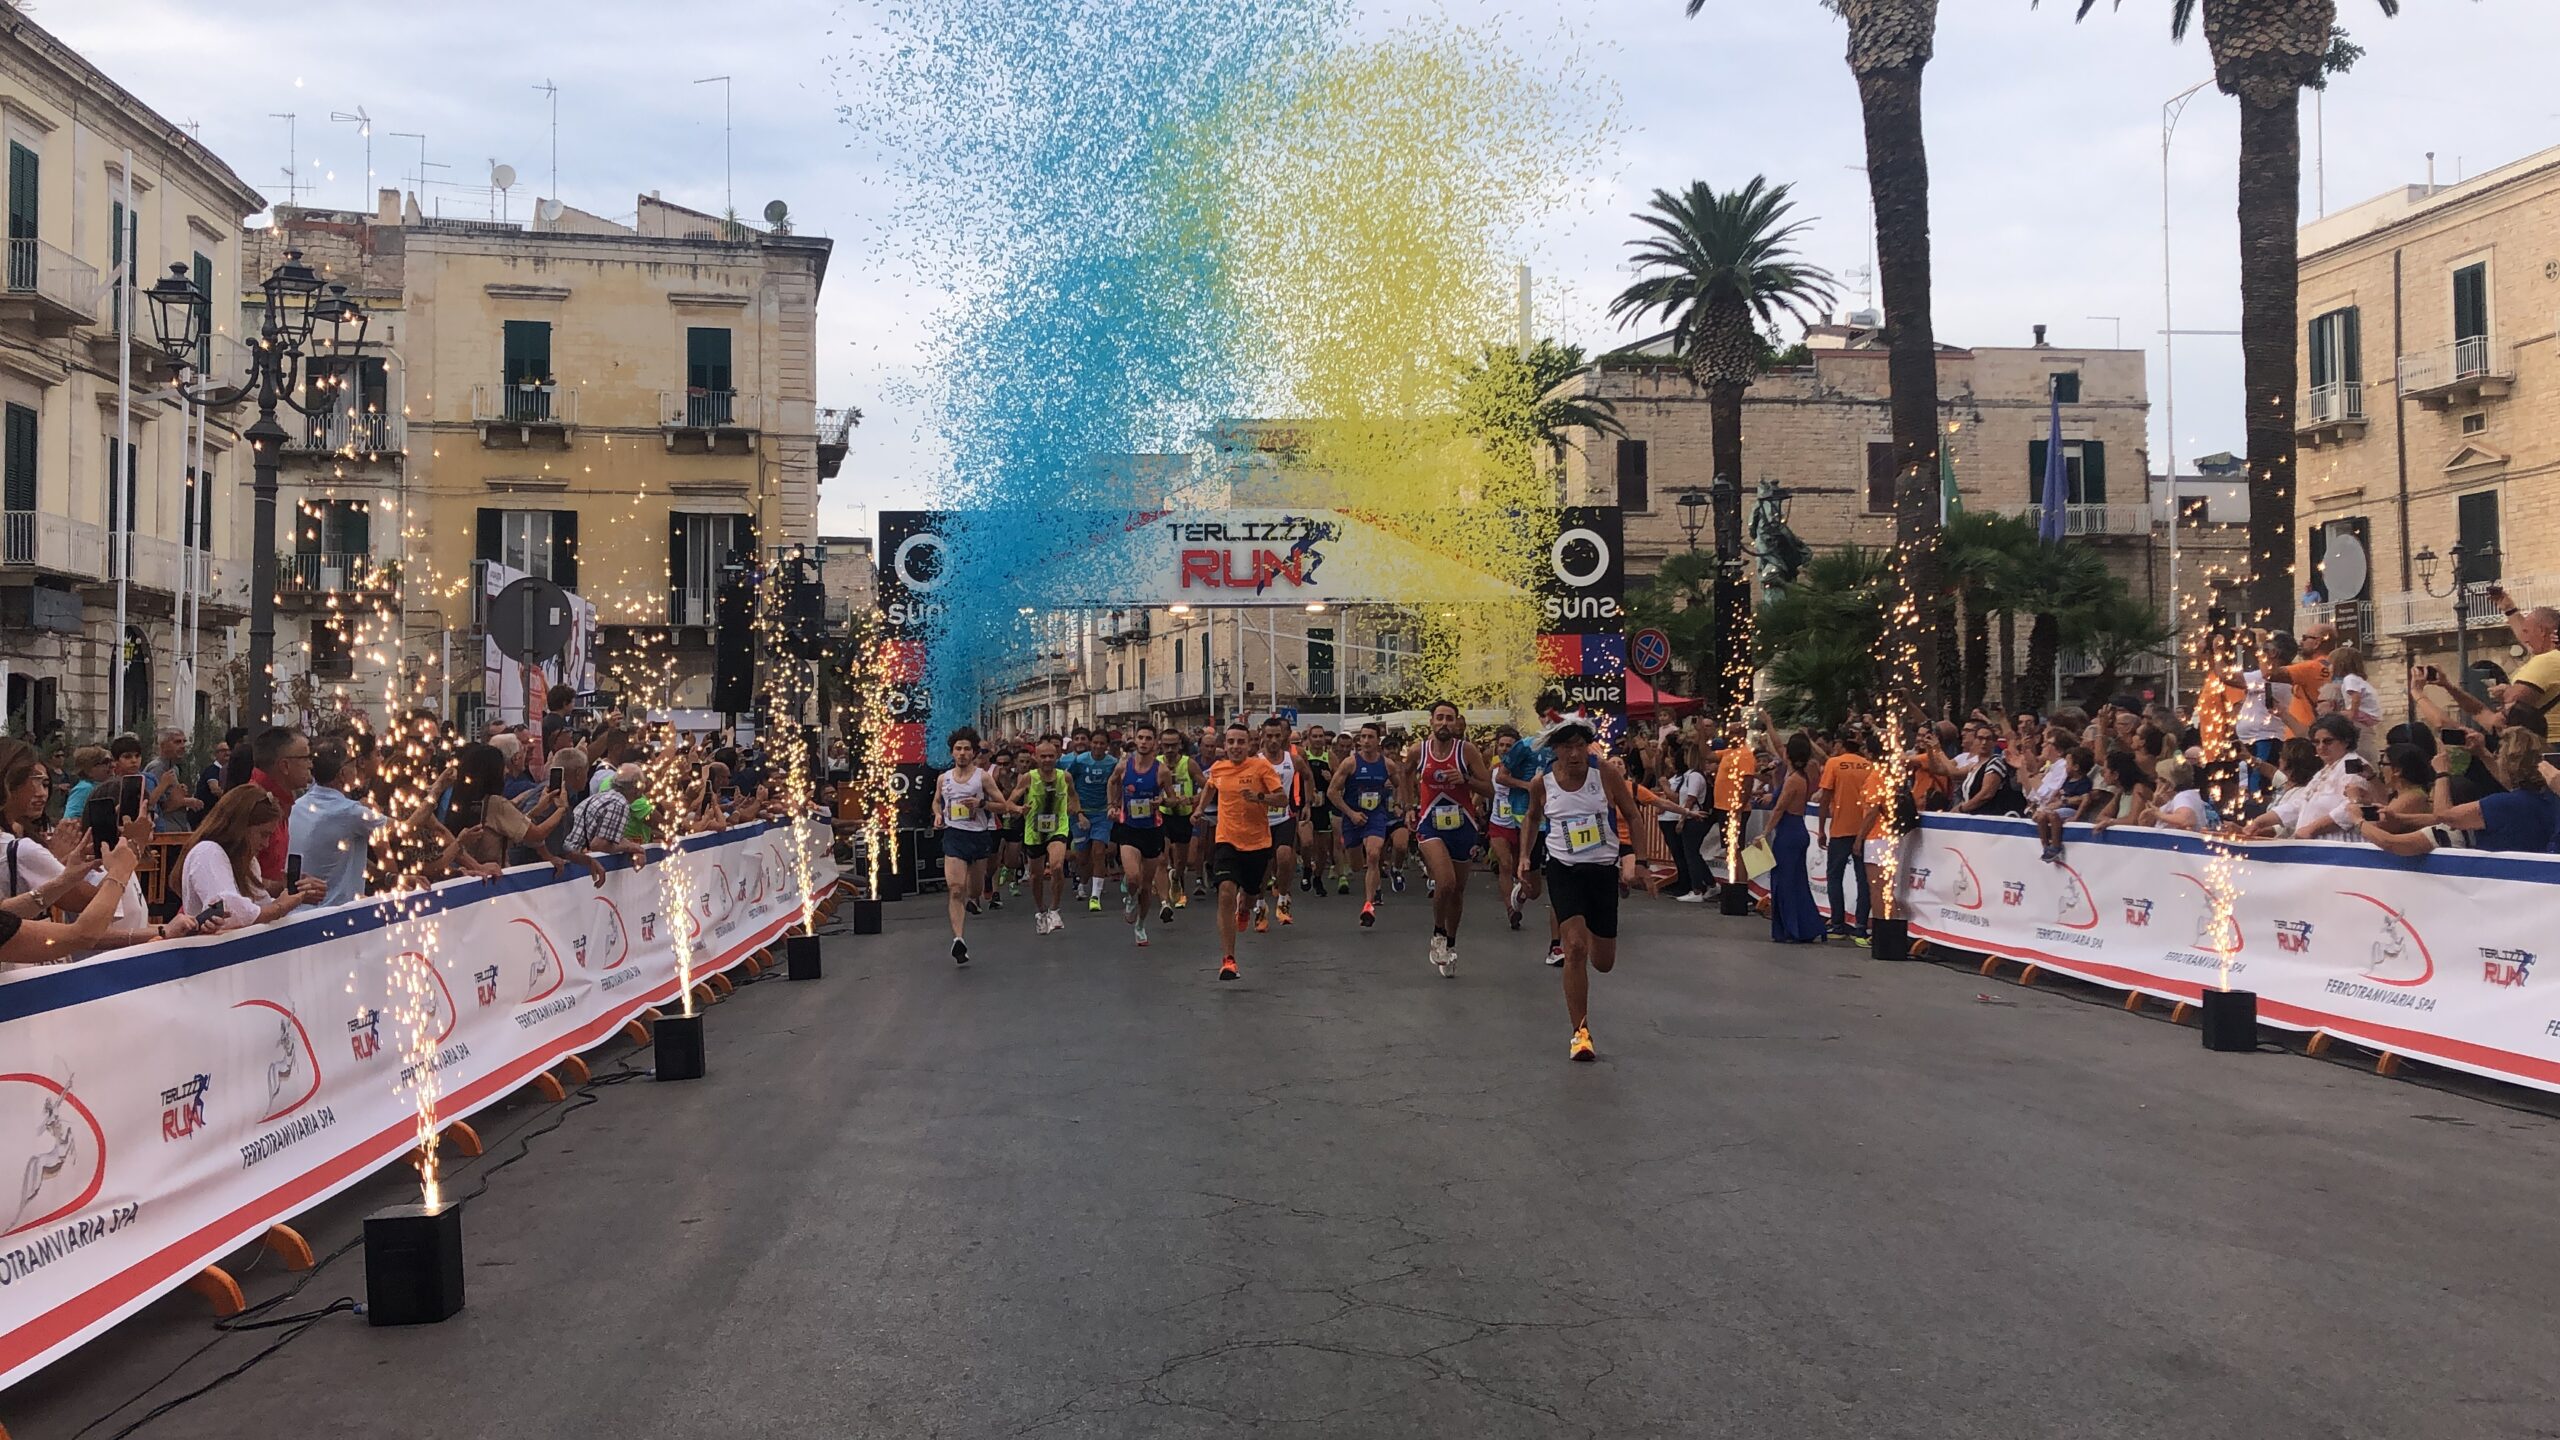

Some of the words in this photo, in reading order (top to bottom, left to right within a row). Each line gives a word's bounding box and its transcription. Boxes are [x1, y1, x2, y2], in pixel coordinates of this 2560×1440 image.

[1181, 549, 1303, 588] RUN
[887, 603, 944, 626] sun
[1137, 806, 1143, 815] 2
[1444, 815, 1452, 826] 6
[1577, 829, 1591, 844] 77
[2276, 932, 2309, 954] RUN
[2478, 946, 2531, 964] TERLIZZ
[2483, 961, 2523, 988] RUN
[2324, 978, 2417, 1008] FERROTRAMVIARIA
[2414, 997, 2438, 1013] SPA
[351, 1031, 378, 1062] RUN
[455, 1041, 472, 1061] SPA
[160, 1078, 205, 1107] TERLIZZ
[162, 1103, 202, 1143] RUN
[240, 1113, 321, 1170] FERROTRAMVIARIA
[317, 1105, 337, 1129] SPA
[109, 1202, 139, 1234] SPA
